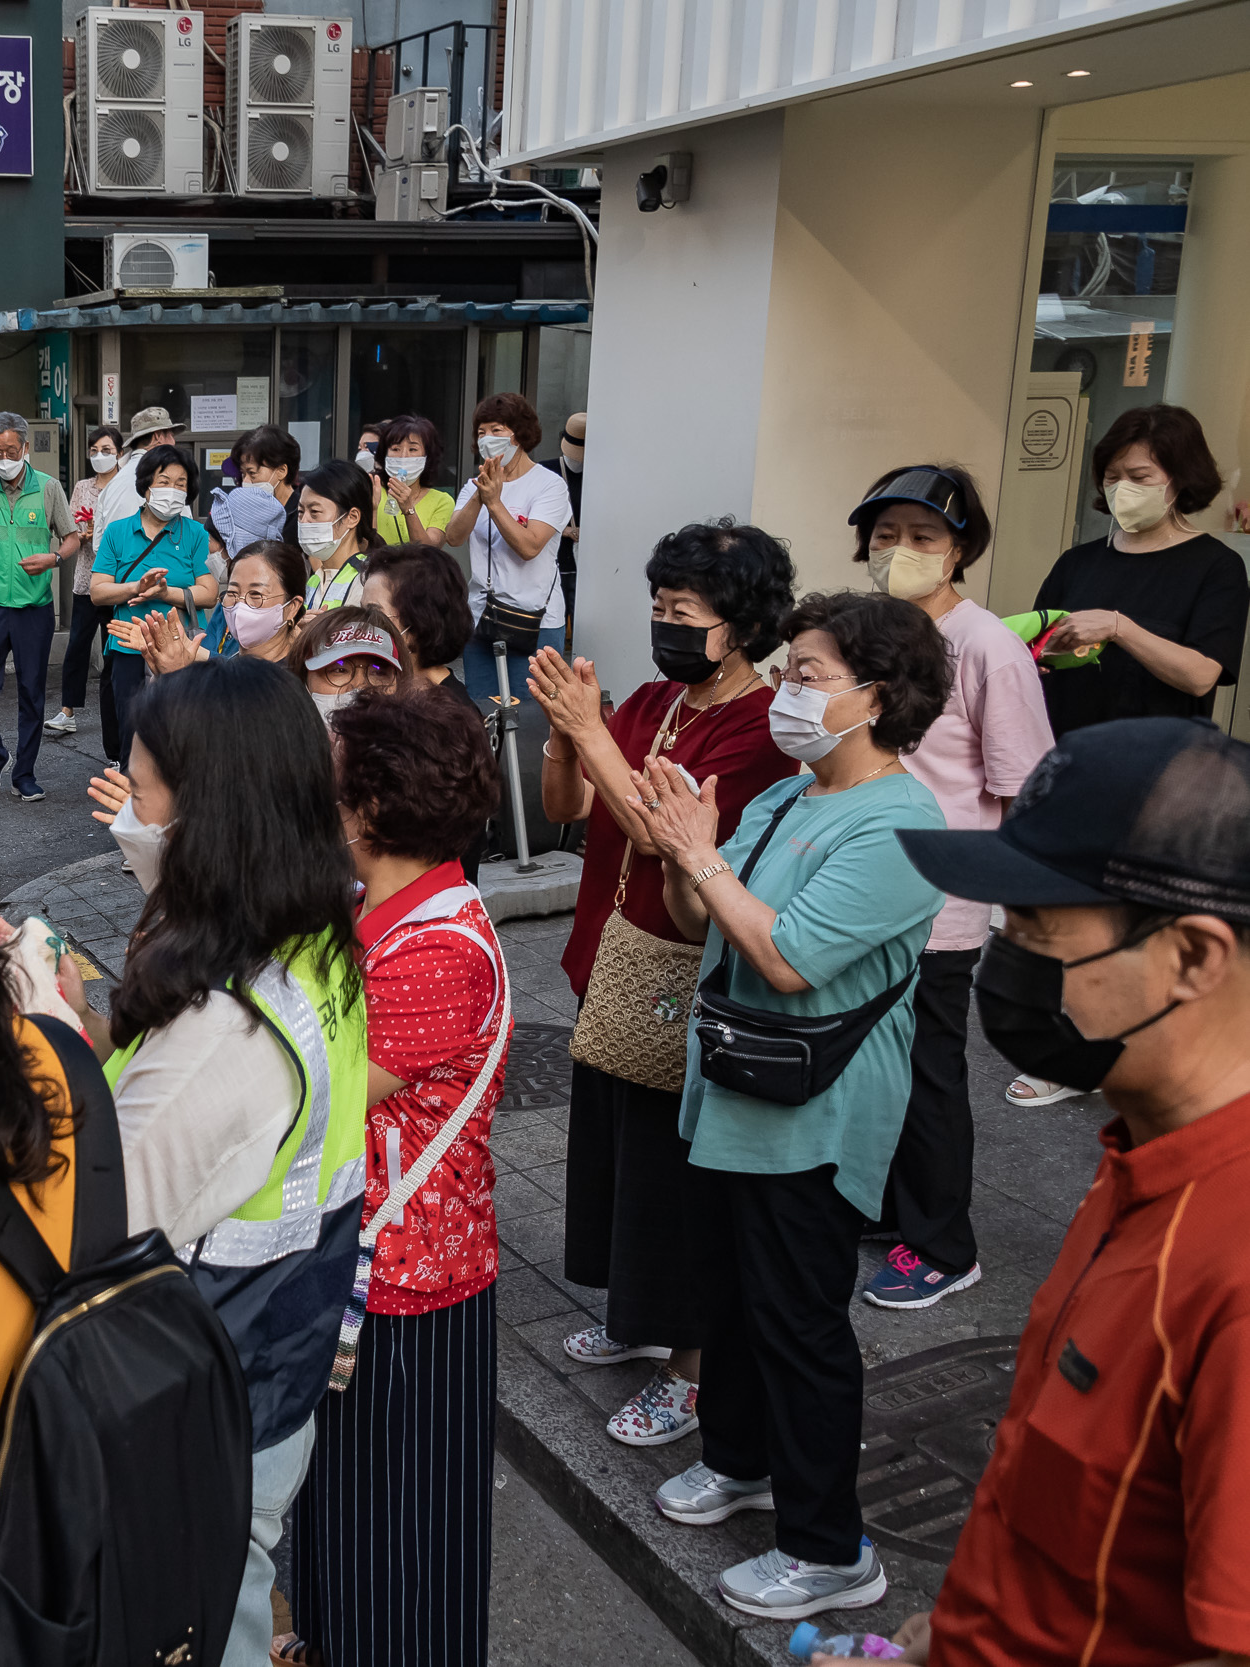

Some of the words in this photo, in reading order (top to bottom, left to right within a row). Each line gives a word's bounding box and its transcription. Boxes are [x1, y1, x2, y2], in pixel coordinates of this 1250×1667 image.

[177, 37, 192, 48] LG
[327, 43, 341, 53] LG
[107, 376, 115, 397] CCTV
[324, 625, 384, 649] Titleist
